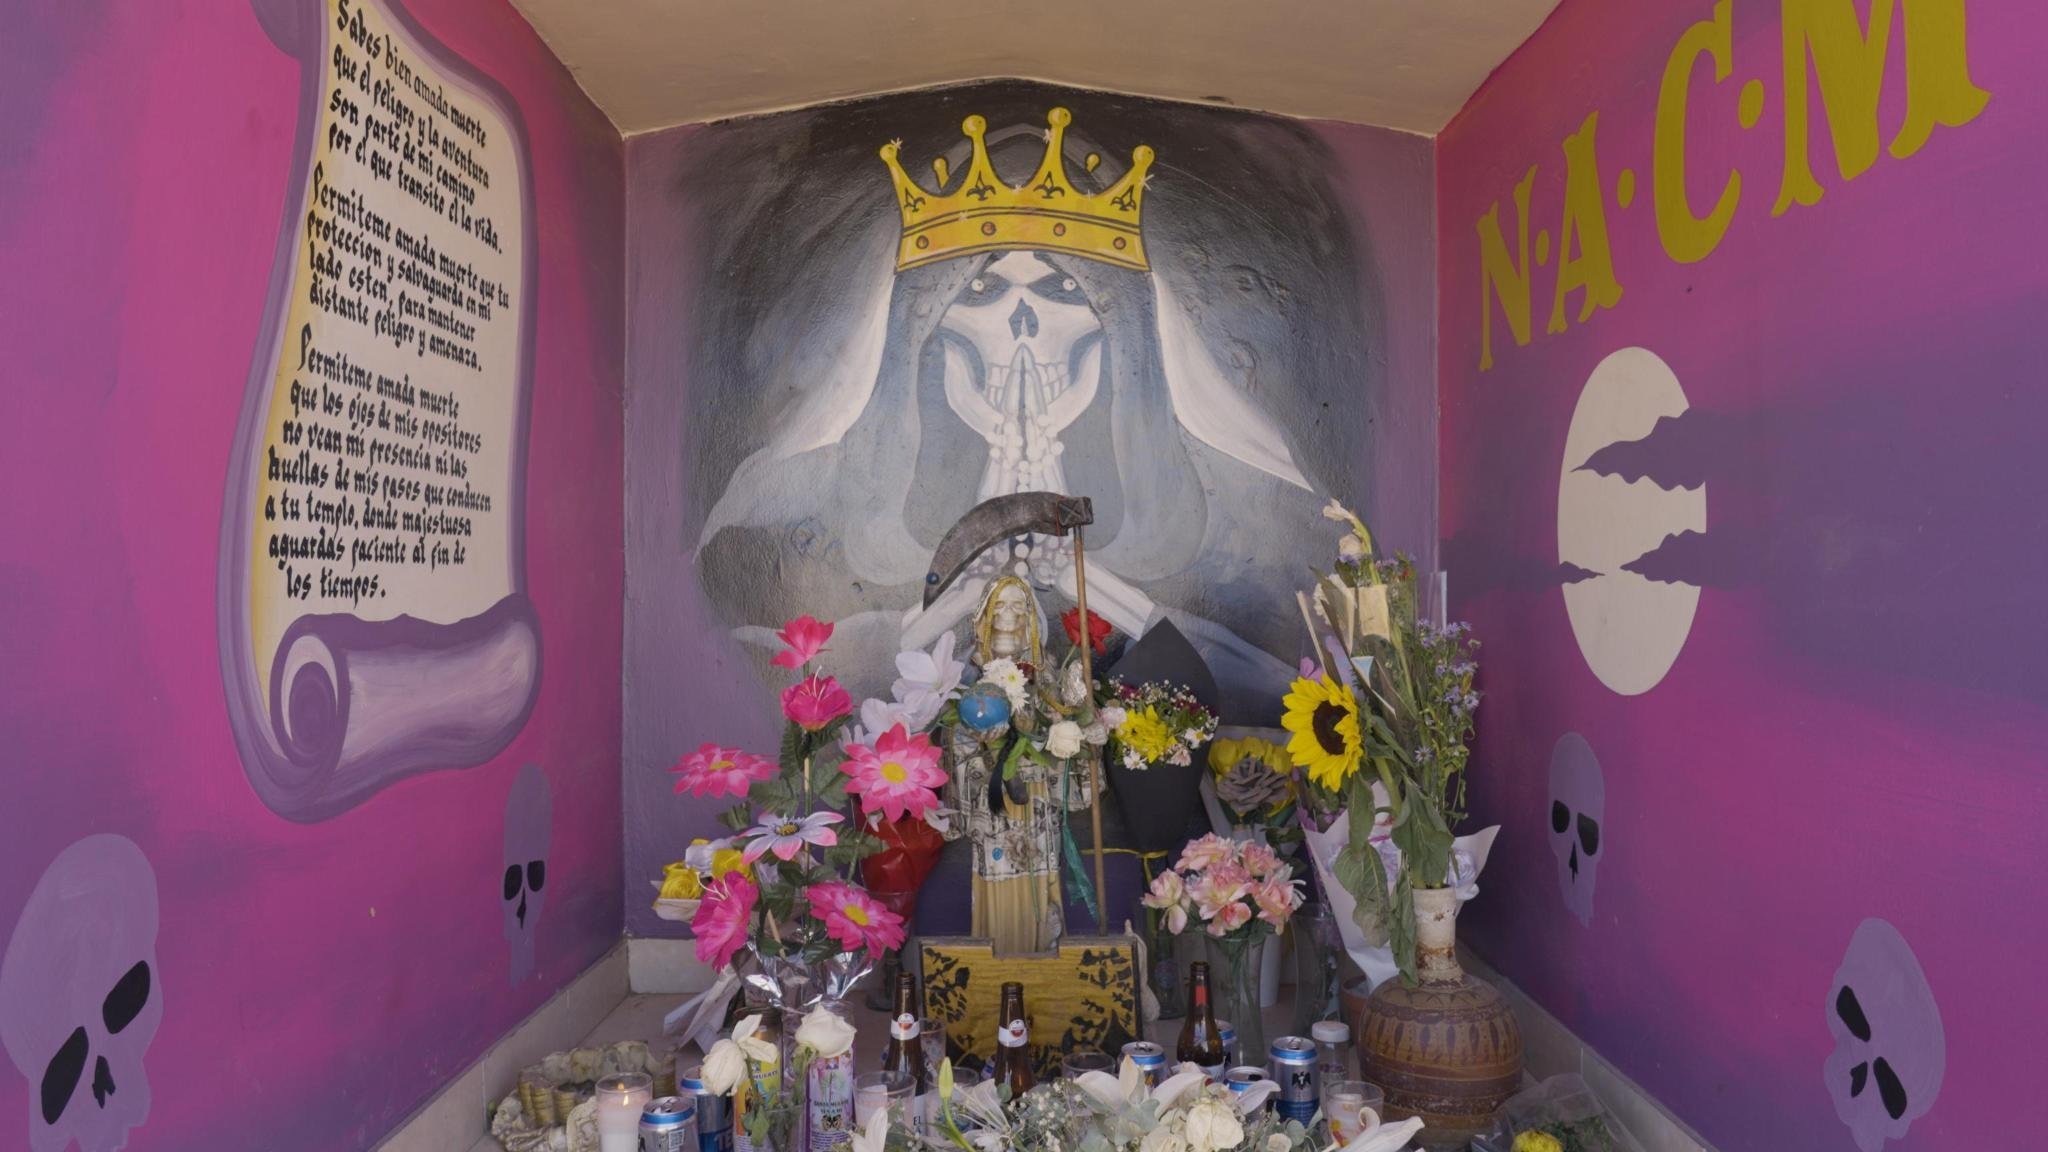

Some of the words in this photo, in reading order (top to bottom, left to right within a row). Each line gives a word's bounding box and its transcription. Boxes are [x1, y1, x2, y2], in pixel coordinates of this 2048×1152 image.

[334, 44, 357, 83] que
[360, 61, 370, 95] el
[374, 80, 414, 130] peligro
[418, 117, 425, 147] y
[428, 115, 439, 148] la
[442, 136, 489, 190] aventura
[337, 0, 381, 59] Sabes
[385, 34, 411, 87] bien
[414, 76, 449, 119] amada
[451, 106, 486, 148] muerte
[356, 136, 366, 165] el
[371, 149, 392, 181] que
[461, 205, 471, 231] la
[475, 217, 503, 254] vida.
[365, 114, 400, 153] parte
[403, 131, 416, 165] de
[418, 151, 433, 177] mi
[436, 164, 475, 206] camino
[313, 160, 391, 242] Permiteme
[395, 227, 436, 270] amada
[440, 251, 477, 291] muerte
[479, 274, 495, 302] que
[498, 282, 509, 309] tu
[309, 241, 342, 281] lado
[398, 290, 425, 321] para
[428, 304, 475, 342] mantener
[309, 272, 369, 326] distante
[375, 308, 414, 349] peligro
[418, 329, 425, 357] y
[430, 334, 482, 372] amenaza.
[387, 254, 394, 284] y
[398, 259, 463, 307] salvaguarda
[466, 295, 476, 315] en
[478, 302, 491, 321] mi
[290, 378, 317, 419] que
[322, 382, 343, 417] los
[348, 391, 375, 431] ojos
[378, 400, 390, 431] de
[395, 409, 418, 439] mis
[422, 419, 482, 454] opositores
[297, 322, 373, 392] Permiteme
[376, 373, 415, 408] amada
[420, 387, 459, 420] muerte
[268, 445, 328, 488] huellas
[335, 458, 350, 491] de
[354, 466, 379, 496] mis
[383, 475, 420, 503] pasos
[424, 483, 443, 509] que
[447, 481, 491, 513] conducen
[283, 419, 303, 446] no
[307, 422, 342, 452] vean
[346, 428, 365, 458] mi
[369, 438, 431, 471] presencia
[435, 450, 448, 475] ni
[451, 453, 467, 479] las
[264, 494, 276, 521] a
[281, 488, 300, 521] tu
[362, 497, 398, 530] donde
[403, 507, 472, 540] majestuosa
[269, 526, 345, 570] aguardas
[352, 535, 406, 572] paciente
[412, 536, 425, 564] al
[431, 541, 449, 573] fin
[453, 539, 466, 564] de
[286, 565, 311, 600] los
[320, 566, 386, 609] tiempos.
